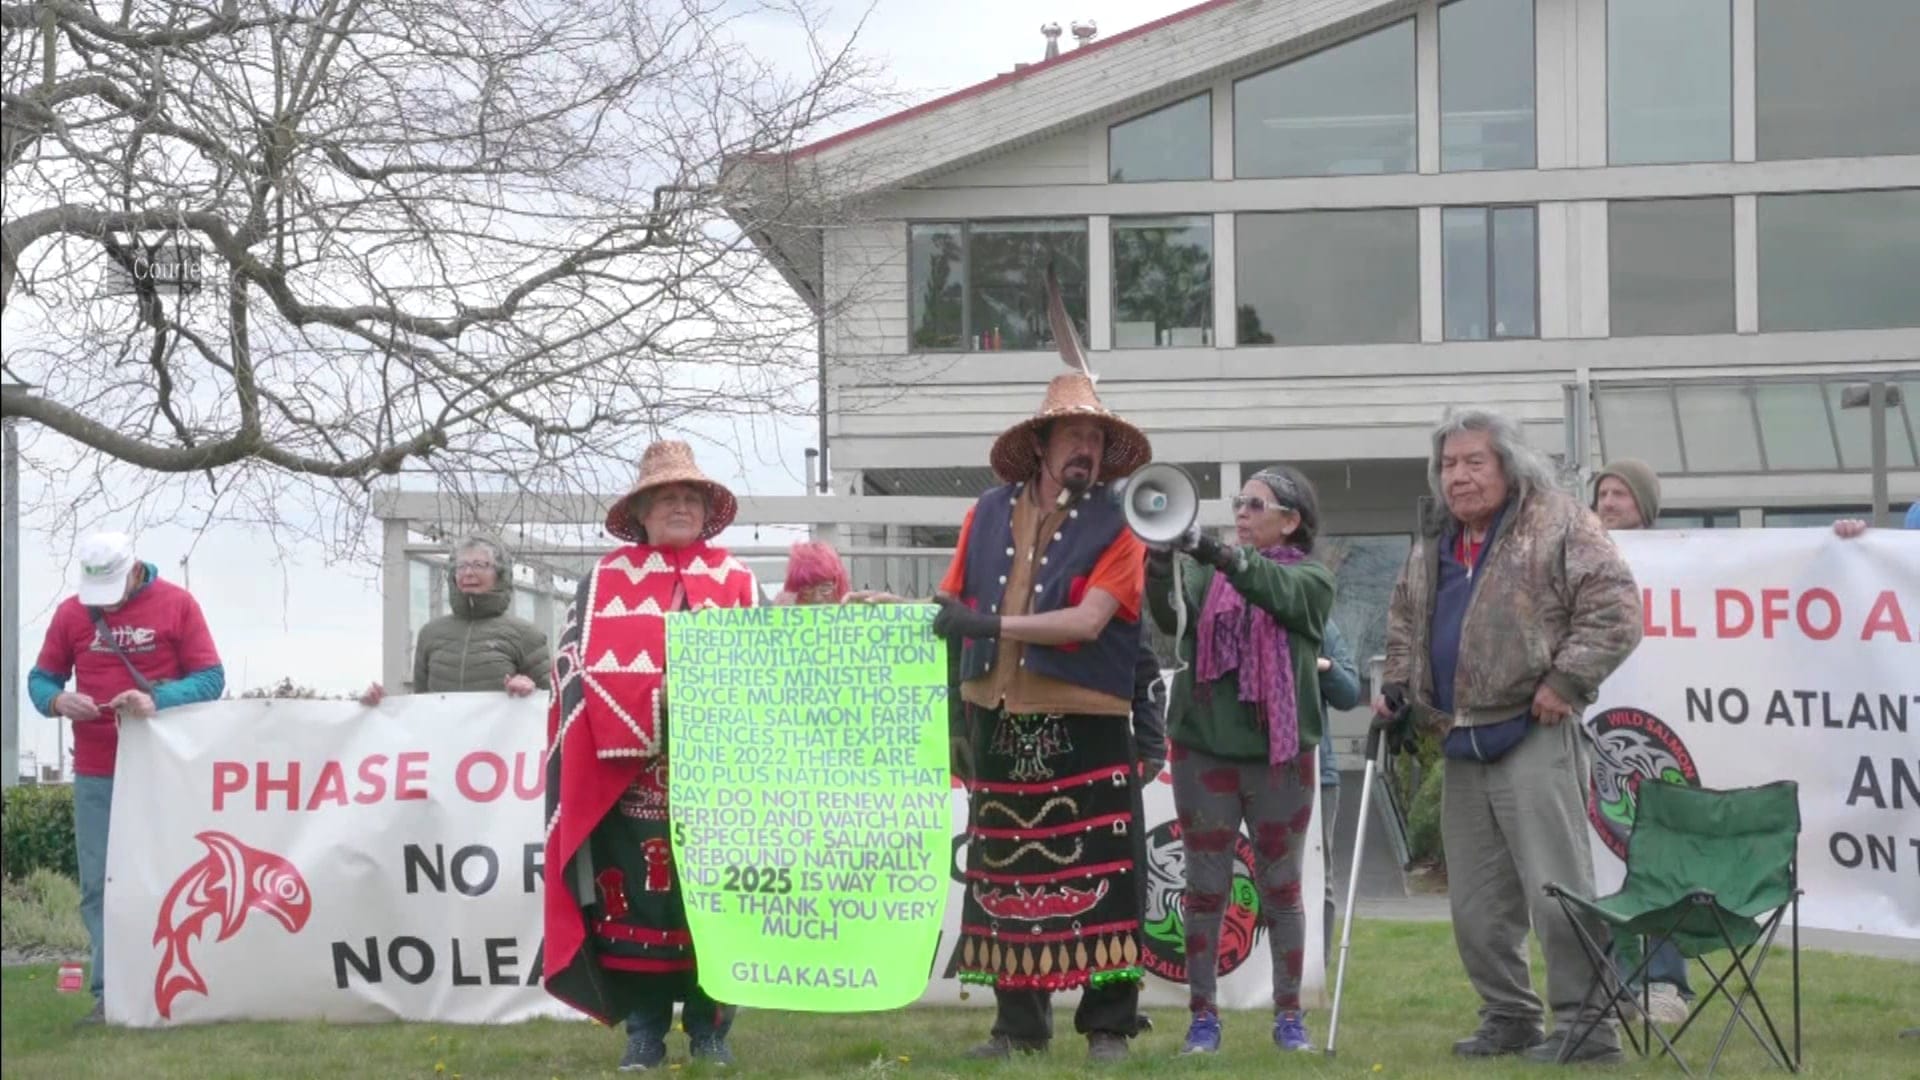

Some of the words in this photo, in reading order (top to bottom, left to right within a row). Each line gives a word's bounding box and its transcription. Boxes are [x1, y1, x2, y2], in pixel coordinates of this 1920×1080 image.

[667, 609, 699, 627] MY
[706, 607, 775, 627] NAME
[782, 607, 804, 627] IS
[1642, 588, 1696, 638] LL
[1715, 587, 1842, 641] DFO
[667, 627, 797, 648] HEREDITARY
[800, 626, 864, 646] CHIEF
[668, 645, 844, 666] LAICHKWILTACH
[850, 644, 936, 665] NATION
[669, 664, 778, 686] FISHERIES
[783, 666, 892, 687] MINISTER
[671, 684, 738, 704] JOYCE
[748, 686, 841, 705] MURRAY
[843, 685, 922, 705] THOSE
[670, 705, 757, 726] FEDERAL
[764, 706, 862, 726] SALMON
[871, 706, 933, 725] FARM
[1686, 687, 1749, 724] NO
[1765, 689, 1920, 732] ATLAN
[670, 724, 775, 745] LICENCES
[780, 728, 838, 747] THAT
[843, 727, 922, 746] EXPIRE
[1606, 710, 1643, 728] WILD
[1645, 718, 1696, 779] SALMON
[671, 742, 727, 763] JUNE
[733, 747, 788, 766] 2022
[795, 750, 865, 767] THERE
[871, 748, 916, 766] ARE
[212, 752, 429, 811] PHASE
[673, 762, 706, 783] 100
[711, 766, 770, 785] PLUS
[776, 766, 881, 786] NATIONS
[887, 768, 946, 787] THAT
[672, 784, 711, 803] SAY
[717, 788, 754, 807] DO
[761, 790, 811, 808] NOT
[816, 791, 896, 809] RENEW
[900, 792, 949, 809] ANY
[672, 804, 757, 826] PERIOD
[763, 809, 813, 828] AND
[818, 809, 899, 829] WATCH
[904, 811, 943, 829] ALL
[675, 822, 687, 847] 5
[690, 828, 783, 849] SPECIES
[788, 829, 815, 849] OF
[823, 830, 923, 850] SALMON
[684, 847, 797, 867] REBOUND
[803, 850, 932, 871] NATURALLY
[1829, 831, 1895, 872] ON
[404, 843, 499, 896] NO
[723, 865, 793, 894] 2025
[800, 871, 823, 891] IS
[827, 872, 877, 893] WAY
[885, 874, 937, 893] TOO
[687, 890, 726, 913] ATE.
[737, 894, 819, 917] THANK
[829, 898, 877, 920] YOU
[883, 899, 939, 921] VERY
[761, 916, 838, 940] MUCH
[332, 935, 435, 989] NO
[731, 962, 878, 988] GILAKASLA
